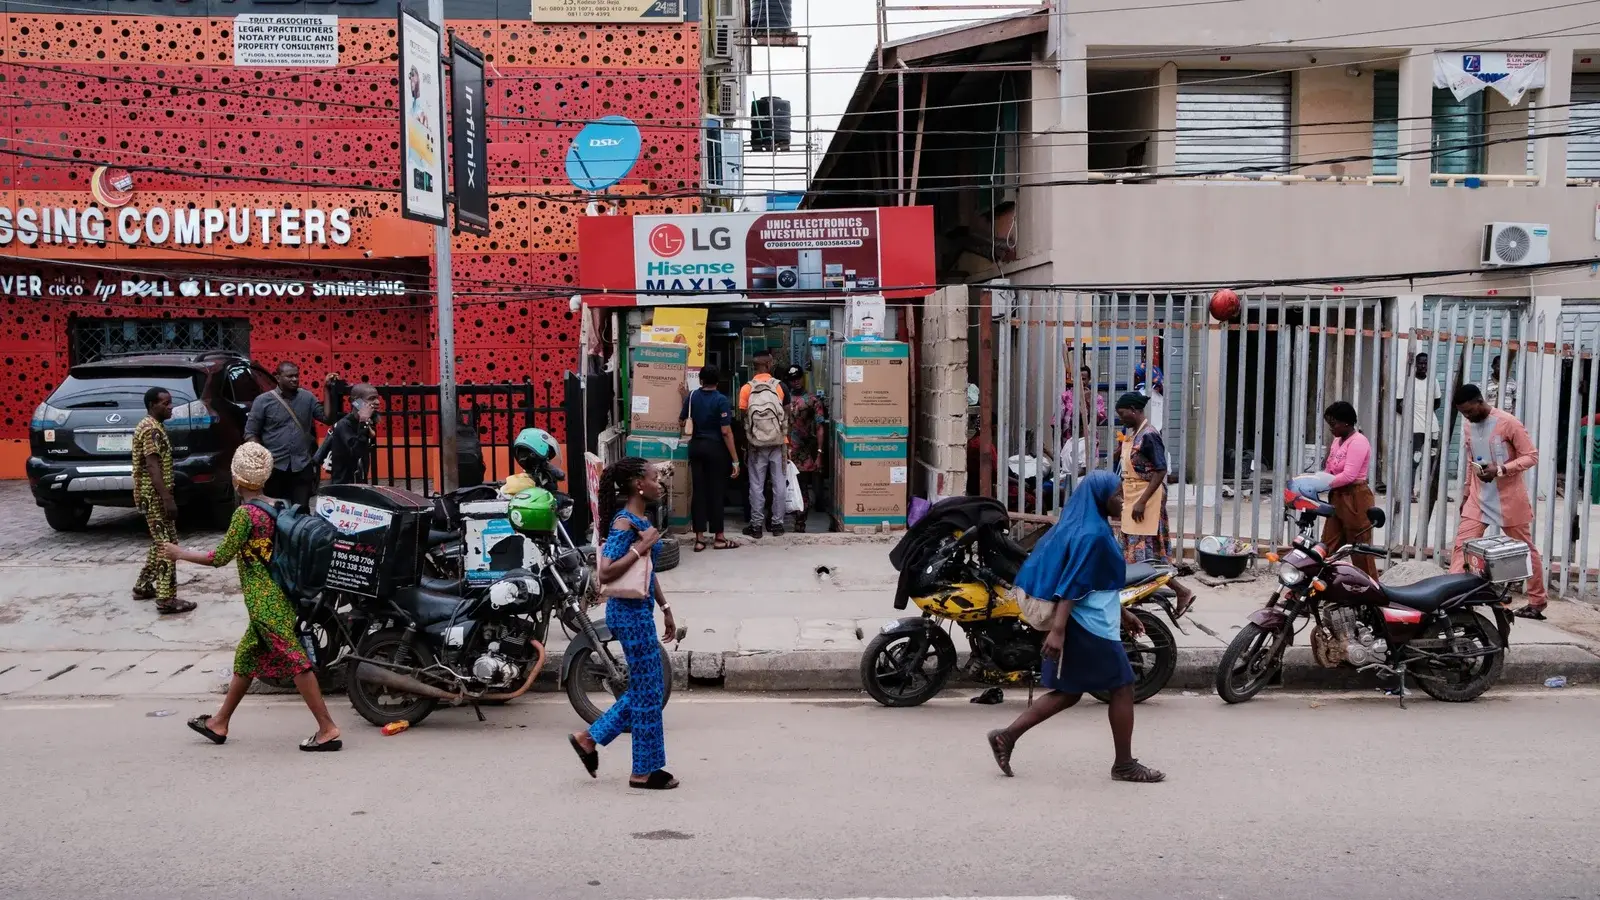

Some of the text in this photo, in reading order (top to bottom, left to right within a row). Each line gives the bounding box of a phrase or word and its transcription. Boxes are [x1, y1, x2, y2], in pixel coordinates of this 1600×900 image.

[654, 1, 667, 12] 24
[249, 17, 274, 25] TRUST
[267, 26, 333, 34] PRACTITIONERS
[281, 43, 334, 51] CONSULTANTS
[465, 85, 477, 189] Infinix
[0, 207, 105, 244] SSING
[118, 206, 351, 244] COMPUTERS
[766, 217, 862, 230] UNIC ELECTRONICS
[692, 227, 731, 251] LG
[760, 227, 870, 240] INVESTMENT INTL LTD
[647, 260, 735, 276] Hisense
[93, 279, 116, 302] hp
[121, 280, 175, 297] DELL
[640, 349, 680, 358] Hisense
[853, 443, 898, 452] Hisense
[338, 520, 359, 530] 24/7
[337, 552, 348, 560] 806
[348, 554, 360, 563] 958
[360, 556, 375, 566] 7706
[335, 560, 373, 574] 912 338 3303
